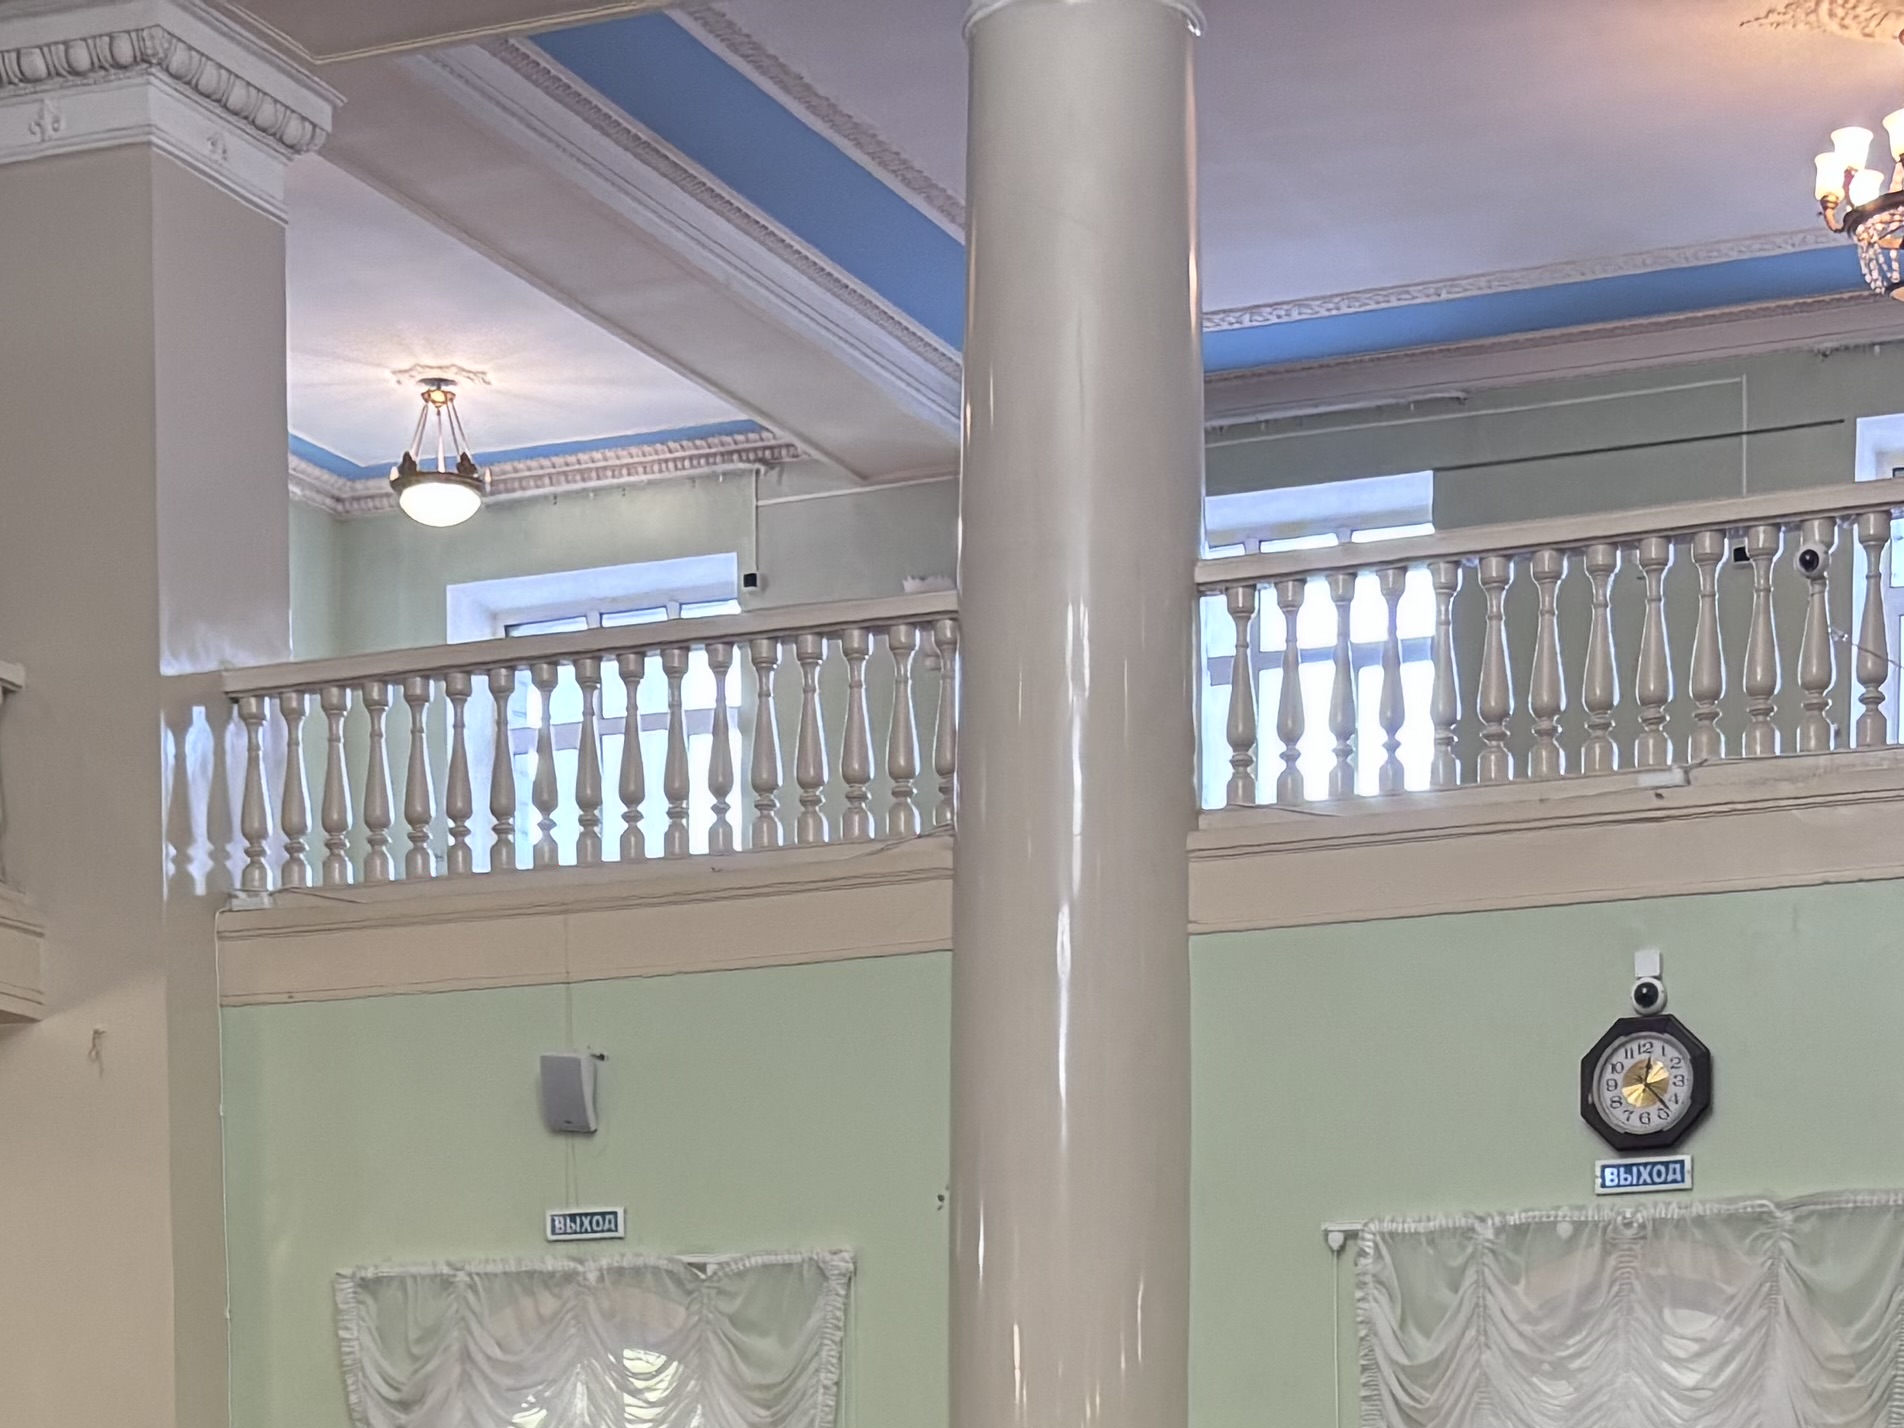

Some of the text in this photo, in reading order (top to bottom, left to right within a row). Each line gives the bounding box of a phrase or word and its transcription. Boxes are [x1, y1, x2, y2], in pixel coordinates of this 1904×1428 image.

[1637, 1041, 1654, 1055] 12
[1603, 1163, 1683, 1187] ВЫХОД
[553, 1213, 616, 1234] ВЫХОД
